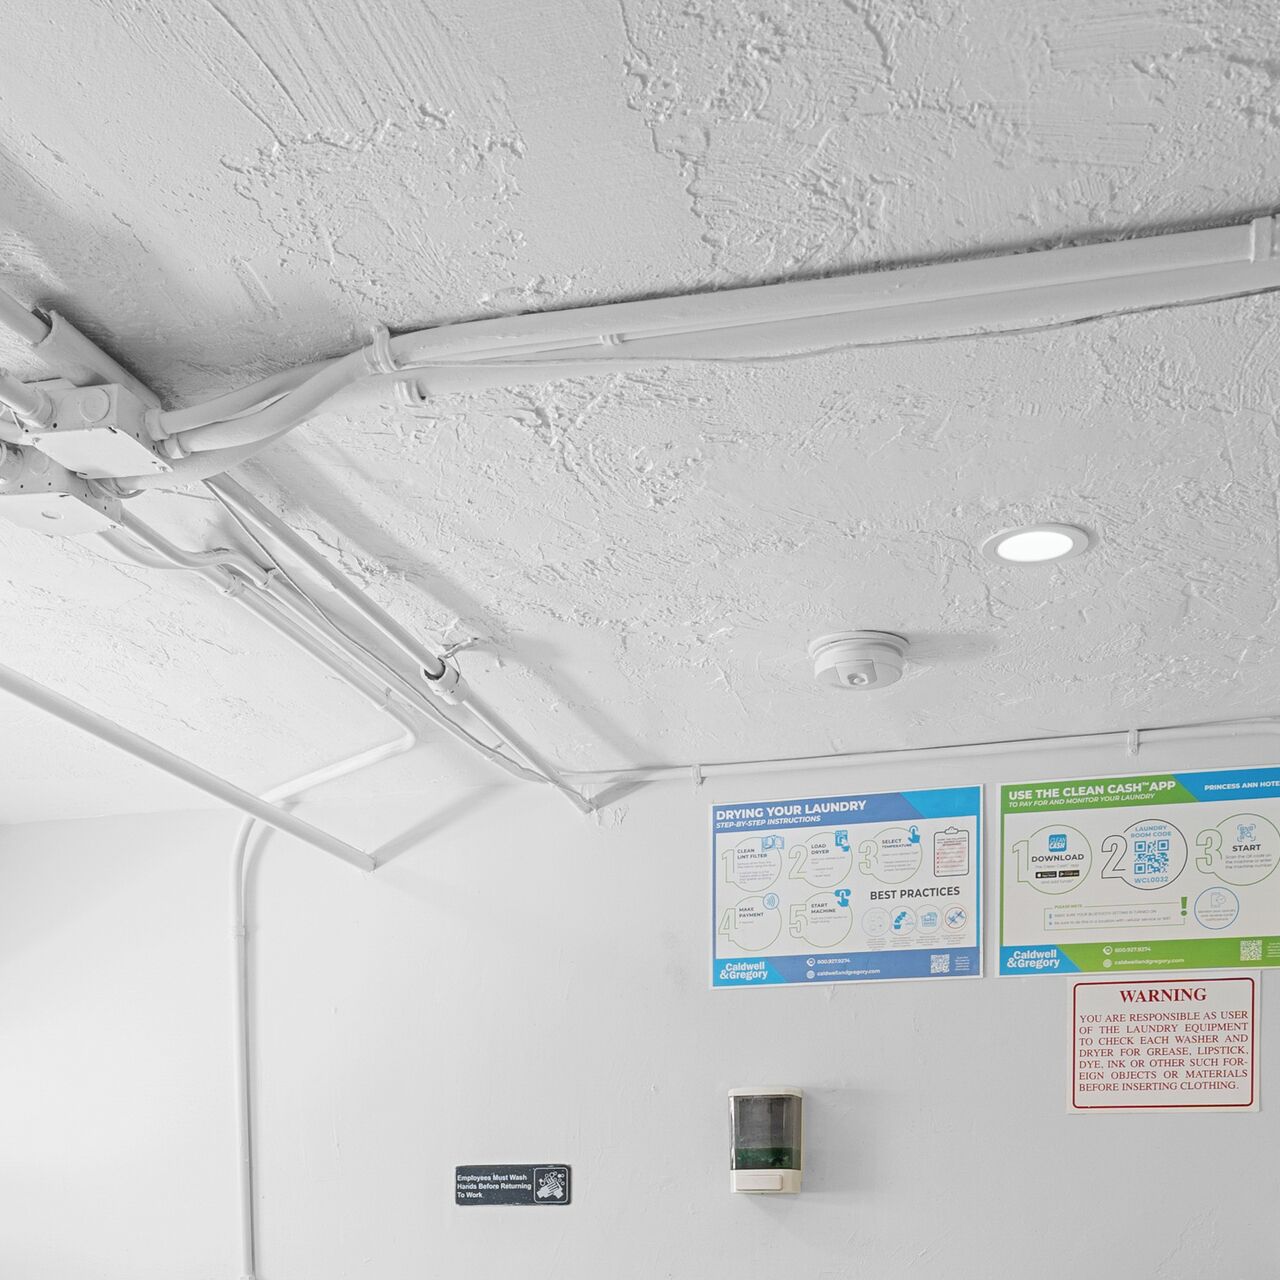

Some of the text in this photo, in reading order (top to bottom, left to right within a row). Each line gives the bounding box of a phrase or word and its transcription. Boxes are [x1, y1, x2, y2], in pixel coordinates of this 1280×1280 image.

[1009, 790, 1032, 800] USE
[1036, 788, 1059, 799] THE
[1063, 786, 1104, 796] CLEAN
[1149, 781, 1176, 791] APP
[1204, 783, 1240, 791] PRINCESS
[1121, 793, 1155, 801] LAUNDRY
[716, 800, 866, 820] DRYING YOUR LAUNDRY
[716, 816, 821, 828] STEP-BY-STEP INSTRUCTIONS
[1232, 844, 1261, 852] START
[1032, 854, 1084, 862] DOWNLOAD
[870, 886, 960, 900] BEST PRACTICES
[1013, 949, 1057, 959] Caldwell
[726, 962, 765, 971] Caldwell
[1007, 958, 1060, 969] &Gregory
[720, 970, 768, 980] &Gregory
[1120, 988, 1206, 1003] WARNING
[1080, 1015, 1101, 1023] YOU
[1105, 1014, 1126, 1022] ARE
[1129, 1012, 1200, 1022] RESPONSIBLE
[1221, 1011, 1248, 1019] USER
[1079, 1023, 1248, 1034] OF THE LAUNDRY EQUIPMENT
[1079, 1034, 1248, 1046] TO CHECK EACH WASHER AND
[1079, 1049, 1113, 1057] DRYER
[1121, 1048, 1140, 1056] FOR
[1107, 1060, 1125, 1068] INK
[1150, 1059, 1184, 1067] OTHER
[1190, 1058, 1218, 1066] SUCH
[1223, 1058, 1247, 1066] FOR-
[1079, 1070, 1247, 1080] EIGN OBJECTS OR MATERIALS
[1079, 1081, 1239, 1091] BEFORE INSERTING CLOTHING.
